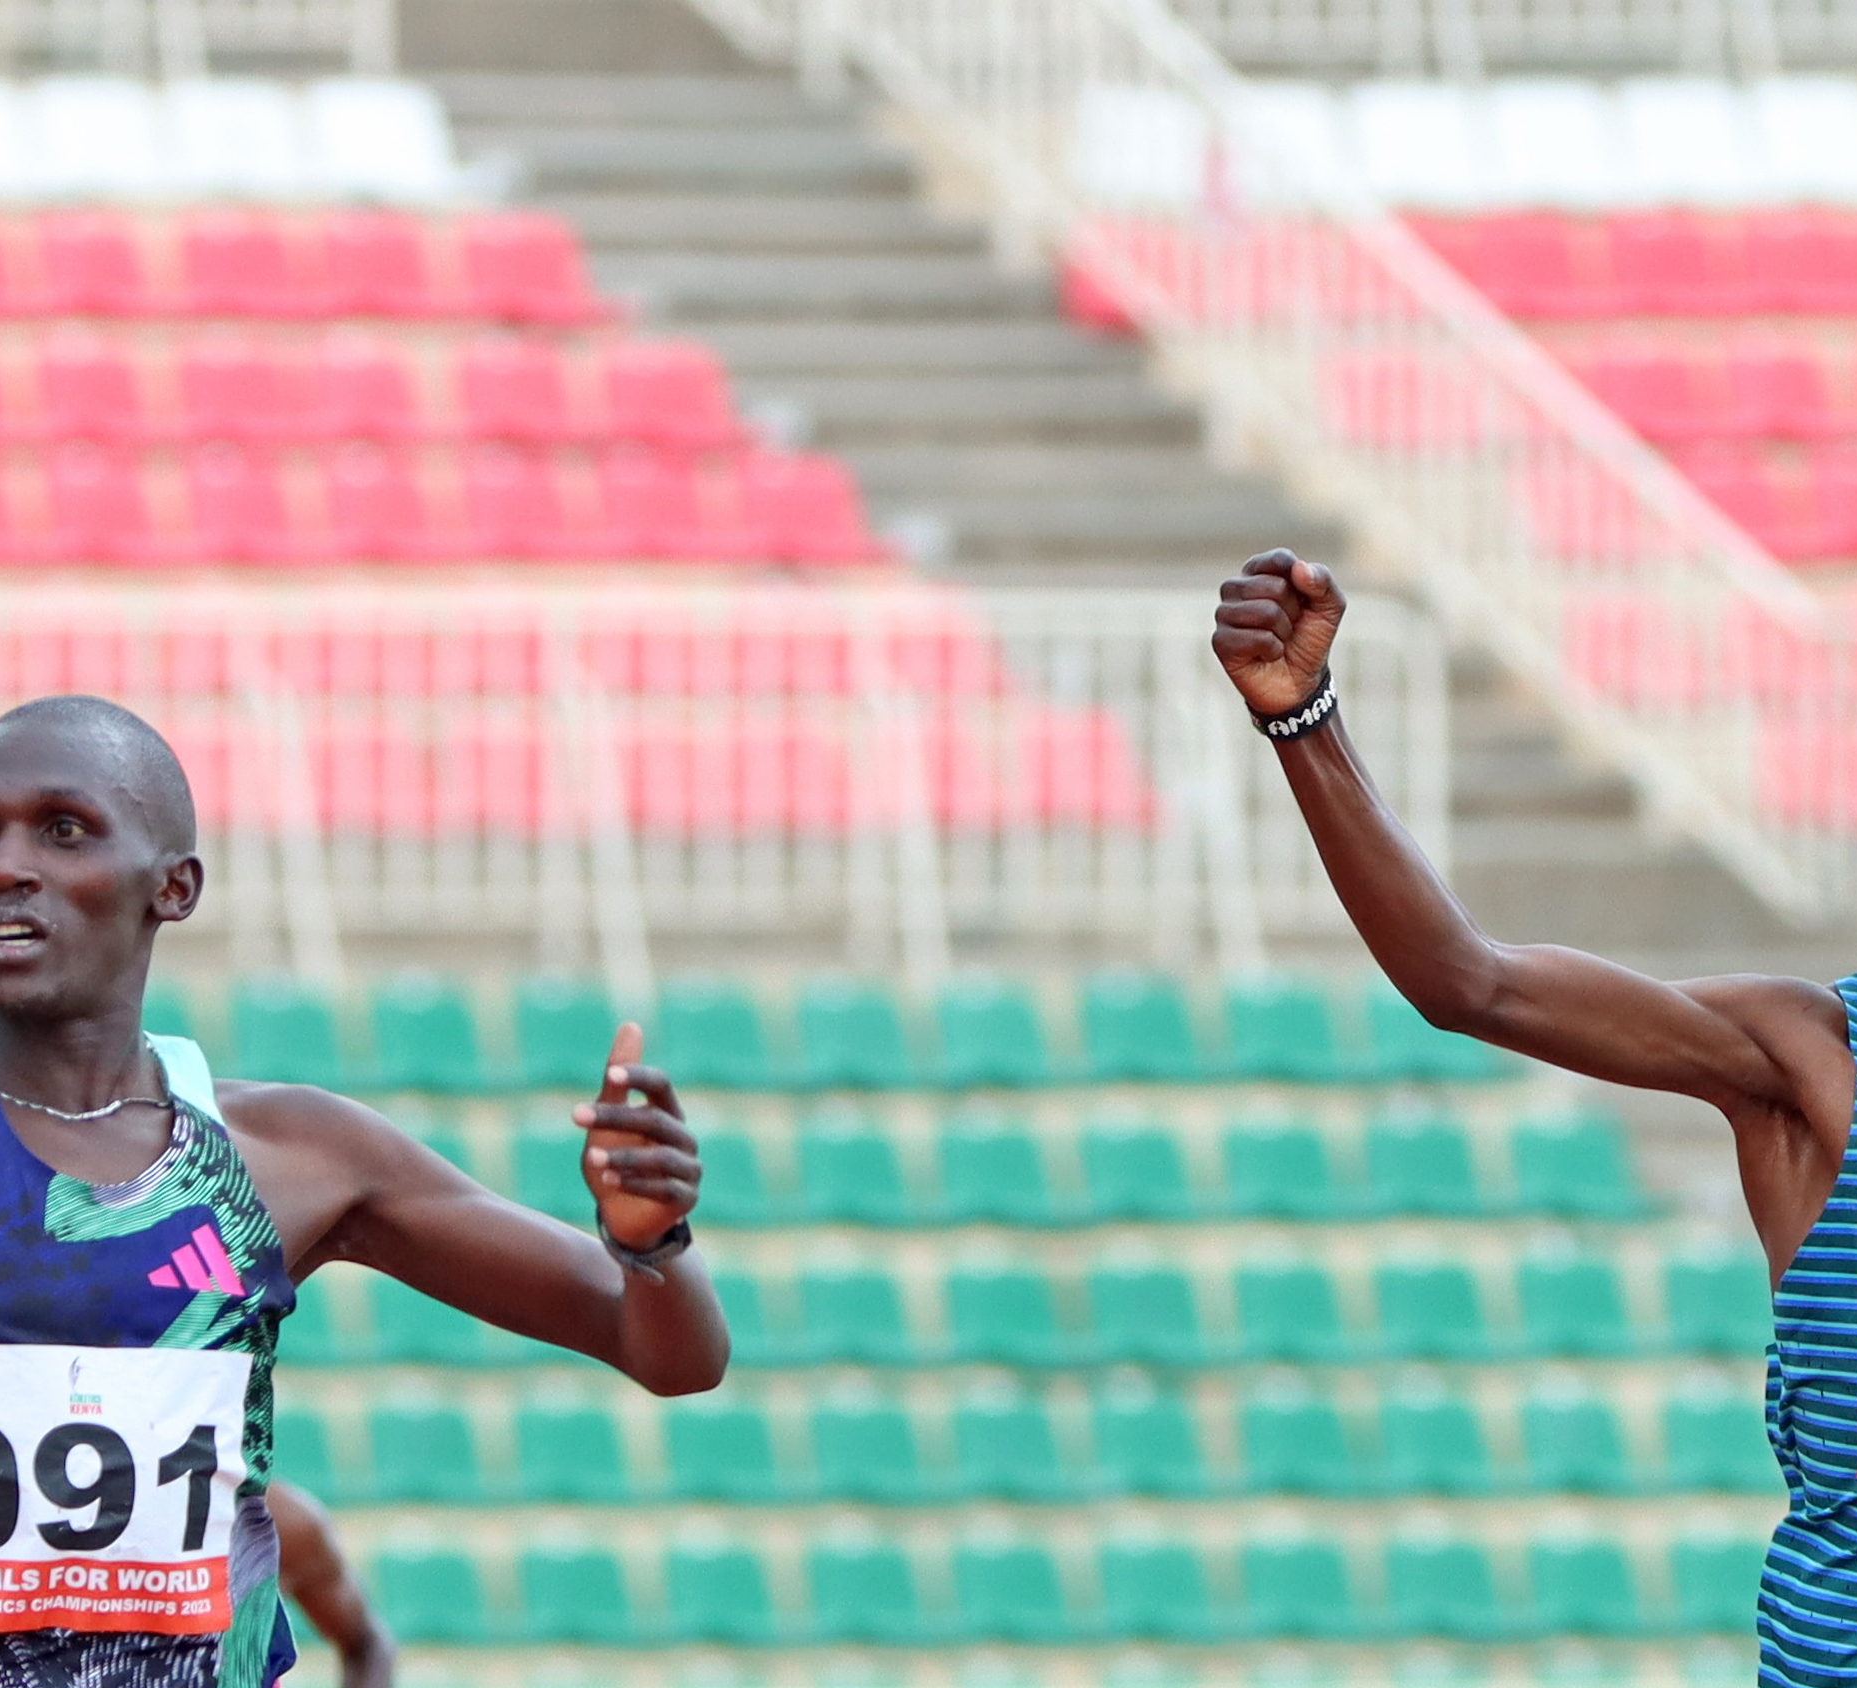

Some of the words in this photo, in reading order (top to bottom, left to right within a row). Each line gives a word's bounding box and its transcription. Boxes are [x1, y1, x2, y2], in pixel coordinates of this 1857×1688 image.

[49, 1565, 109, 1591] FOR
[117, 1567, 211, 1593] WORLD
[31, 1595, 176, 1615] CHAMPIONSHIPS
[180, 1598, 211, 1616] 2023
